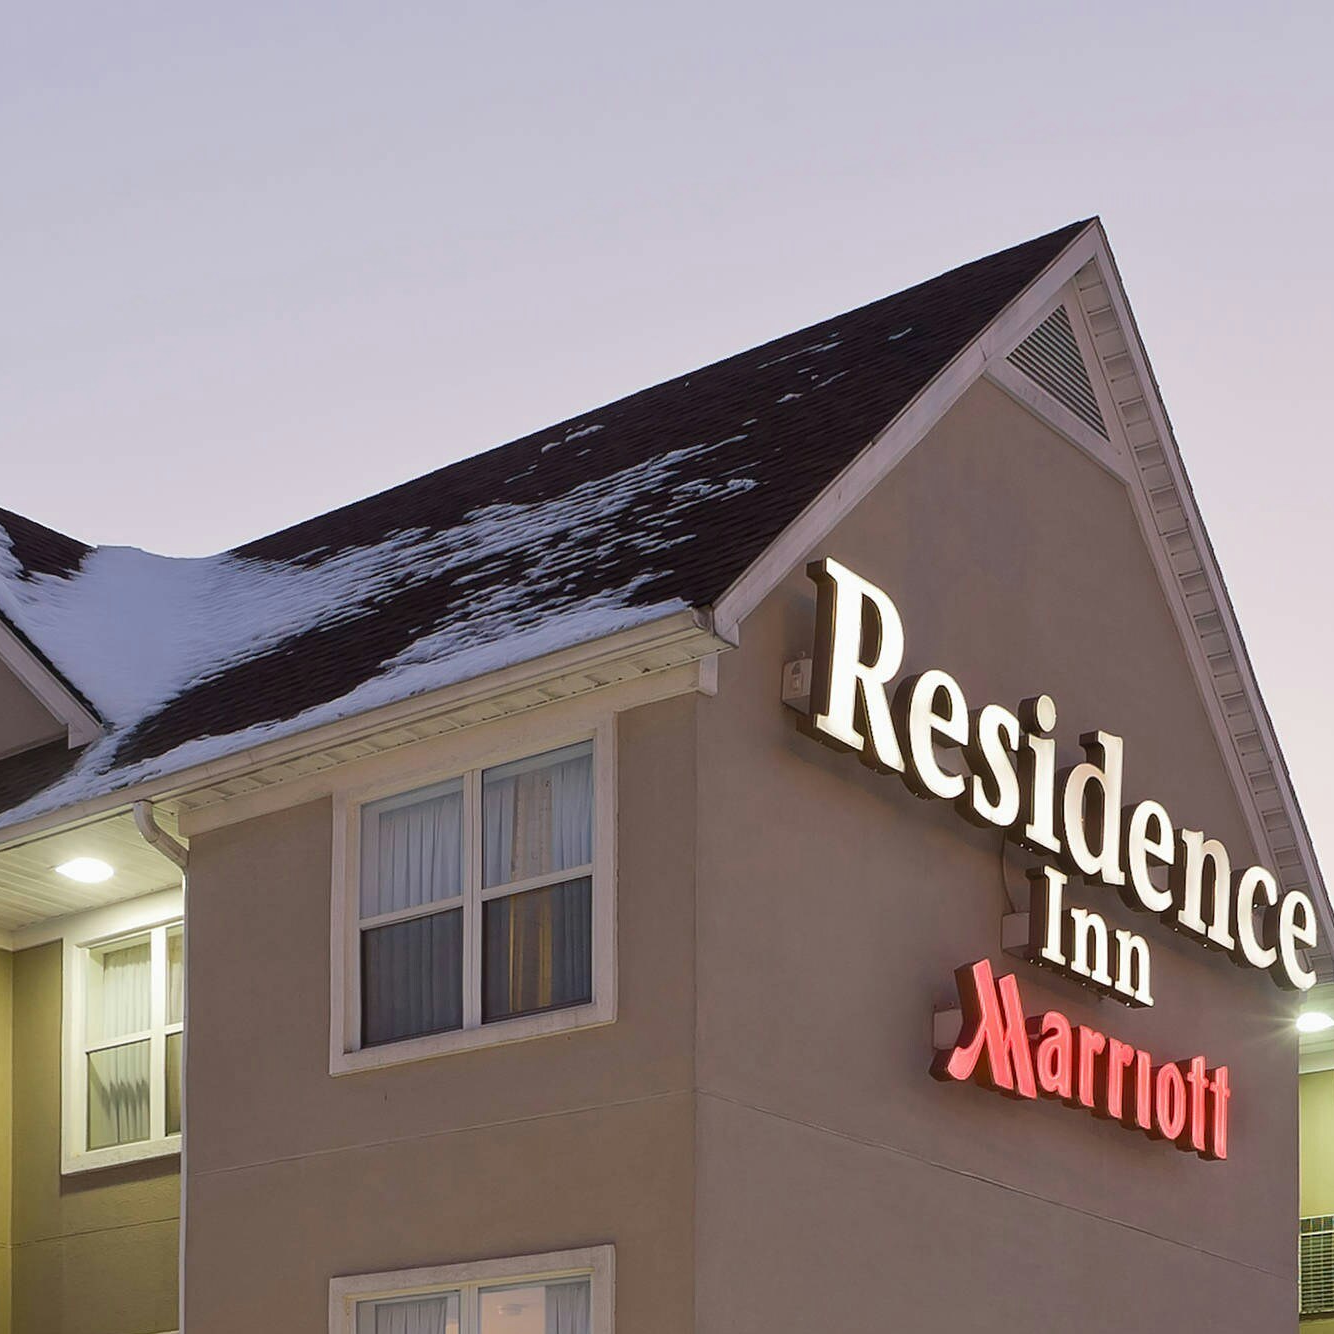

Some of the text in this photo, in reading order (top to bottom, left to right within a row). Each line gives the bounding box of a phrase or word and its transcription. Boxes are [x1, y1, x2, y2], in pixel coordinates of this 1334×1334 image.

[814, 556, 1319, 991] Residence
[1041, 865, 1155, 1007] Inn
[946, 958, 1231, 1160] Marriott
